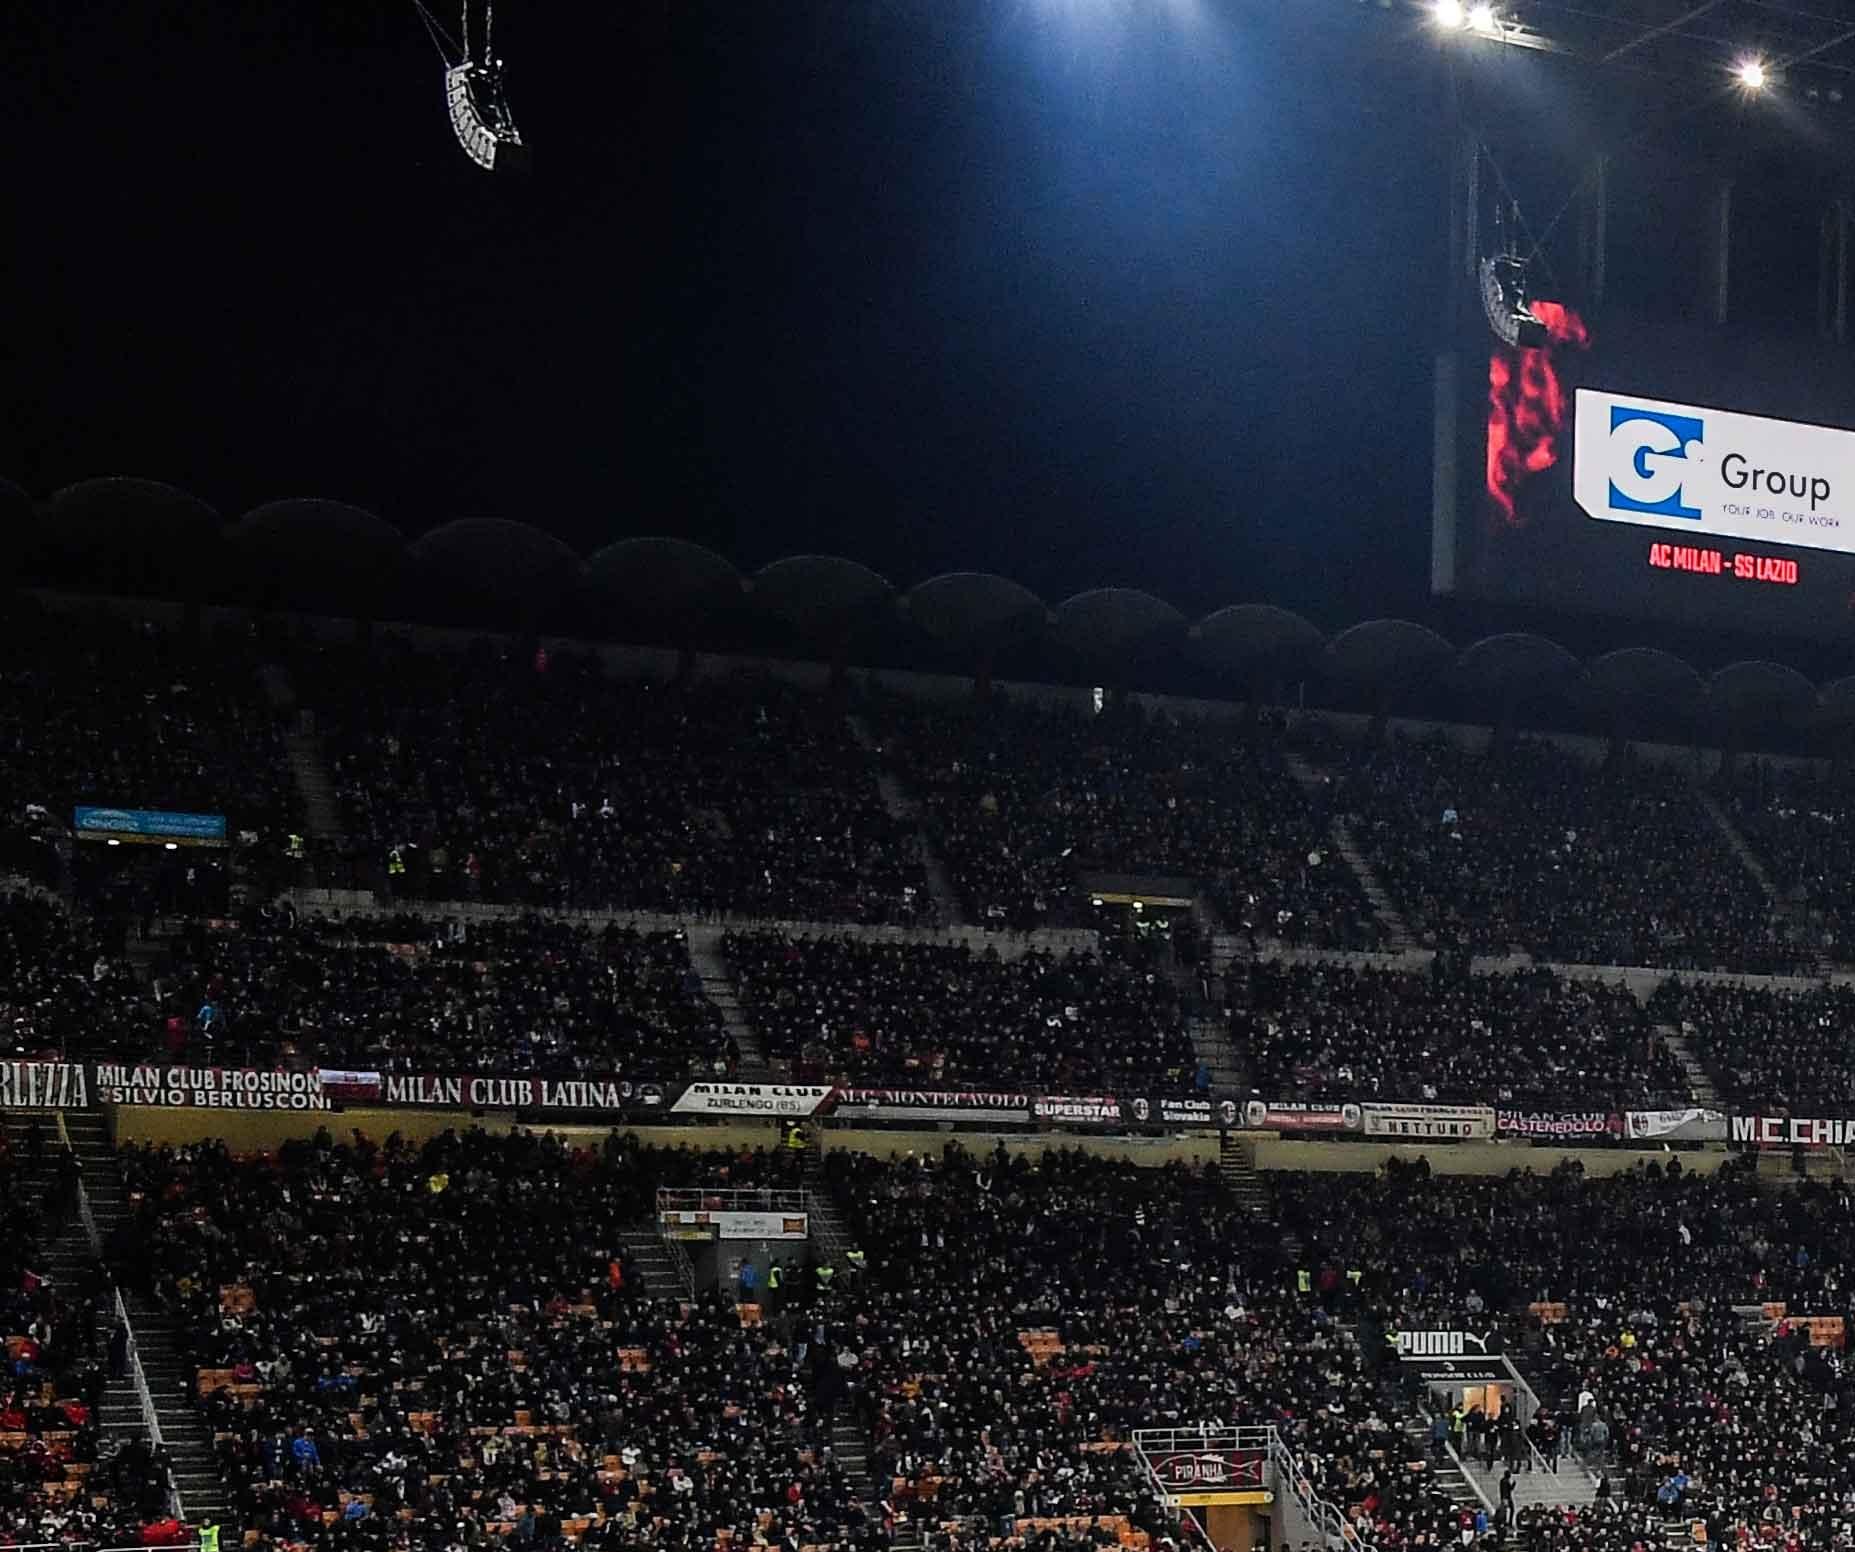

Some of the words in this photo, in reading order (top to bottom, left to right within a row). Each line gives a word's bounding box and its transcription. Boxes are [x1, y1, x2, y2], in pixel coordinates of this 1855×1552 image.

[1721, 453, 1830, 510] Group
[1649, 543, 1671, 568] AC
[1672, 548, 1721, 576] MILAN
[1734, 557, 1754, 580] SS
[1756, 560, 1799, 584] LAZIO
[96, 1065, 161, 1089] MILAN
[166, 1066, 216, 1091] CLUB
[220, 1069, 321, 1094] FROSINON
[386, 1075, 463, 1106] MILAN
[469, 1079, 533, 1106] CLUB
[540, 1082, 621, 1108] LATINA
[693, 1084, 761, 1096] MILAN
[772, 1085, 825, 1097] CLUB
[111, 1086, 185, 1105] SILVIO
[194, 1090, 333, 1110] BERLUSCONI
[1034, 1103, 1120, 1118] SUPERSTAR
[1387, 1120, 1473, 1136] NETTUNO
[1497, 1119, 1603, 1135] CASTENEDOLO
[1397, 1330, 1464, 1355] PUMA
[1173, 1463, 1225, 1482] PIRANHA
